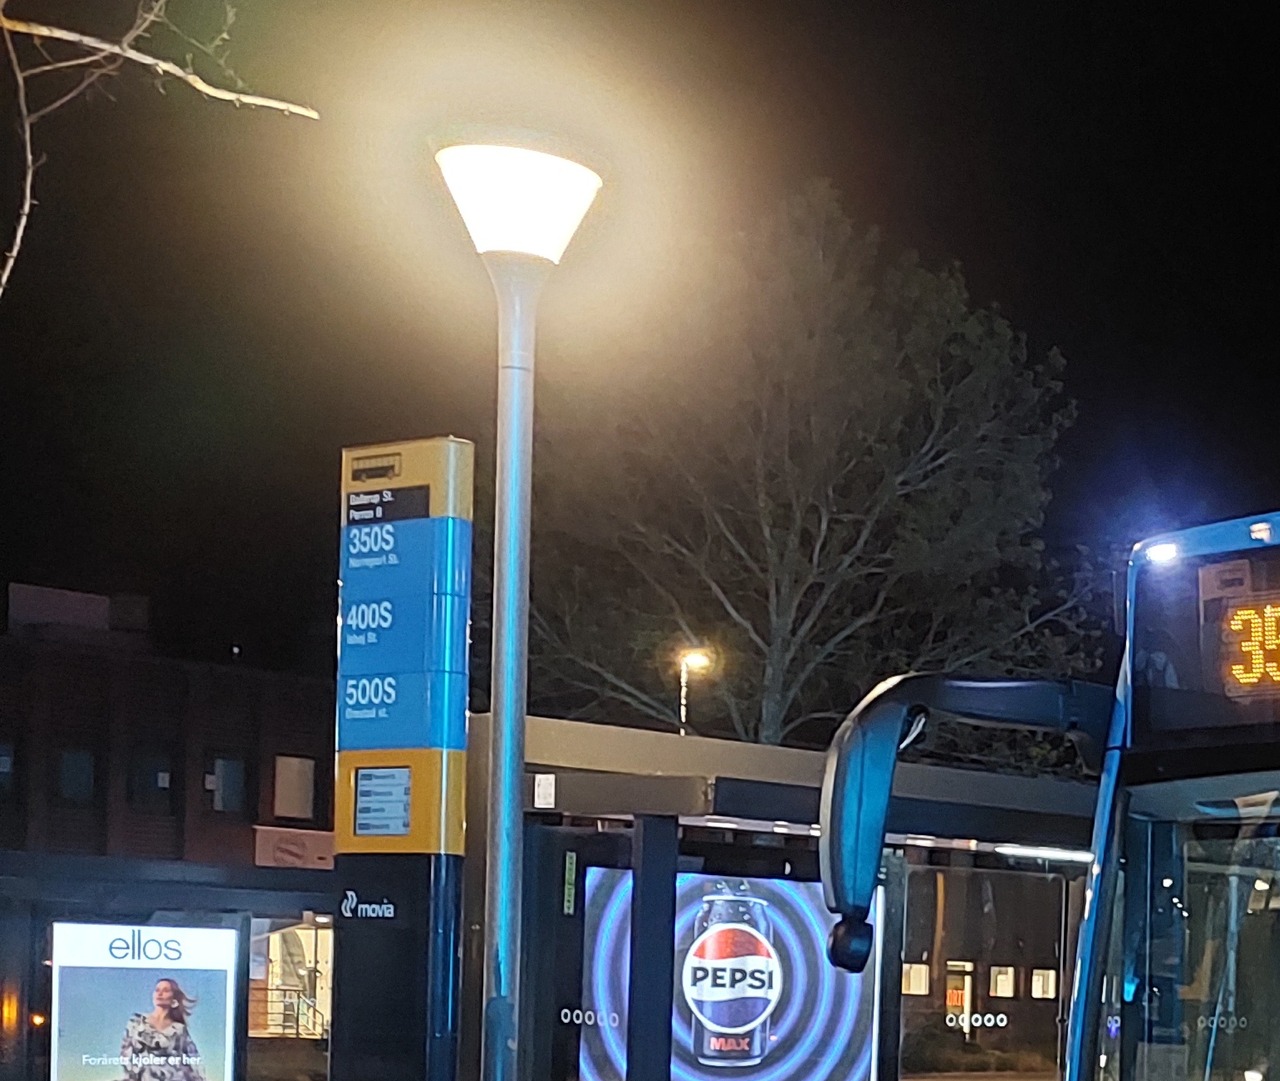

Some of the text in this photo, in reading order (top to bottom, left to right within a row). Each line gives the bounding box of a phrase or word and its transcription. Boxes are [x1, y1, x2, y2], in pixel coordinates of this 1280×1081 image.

[349, 524, 395, 554] 350S
[347, 600, 393, 630] 400S
[345, 677, 396, 705] 500S
[358, 898, 395, 918] movia
[109, 930, 182, 962] ellos
[690, 966, 774, 991] PEPSI
[709, 1035, 750, 1053] MAX
[82, 1053, 129, 1066] Forårets
[132, 1053, 166, 1068] kjoler
[168, 1056, 181, 1066] er
